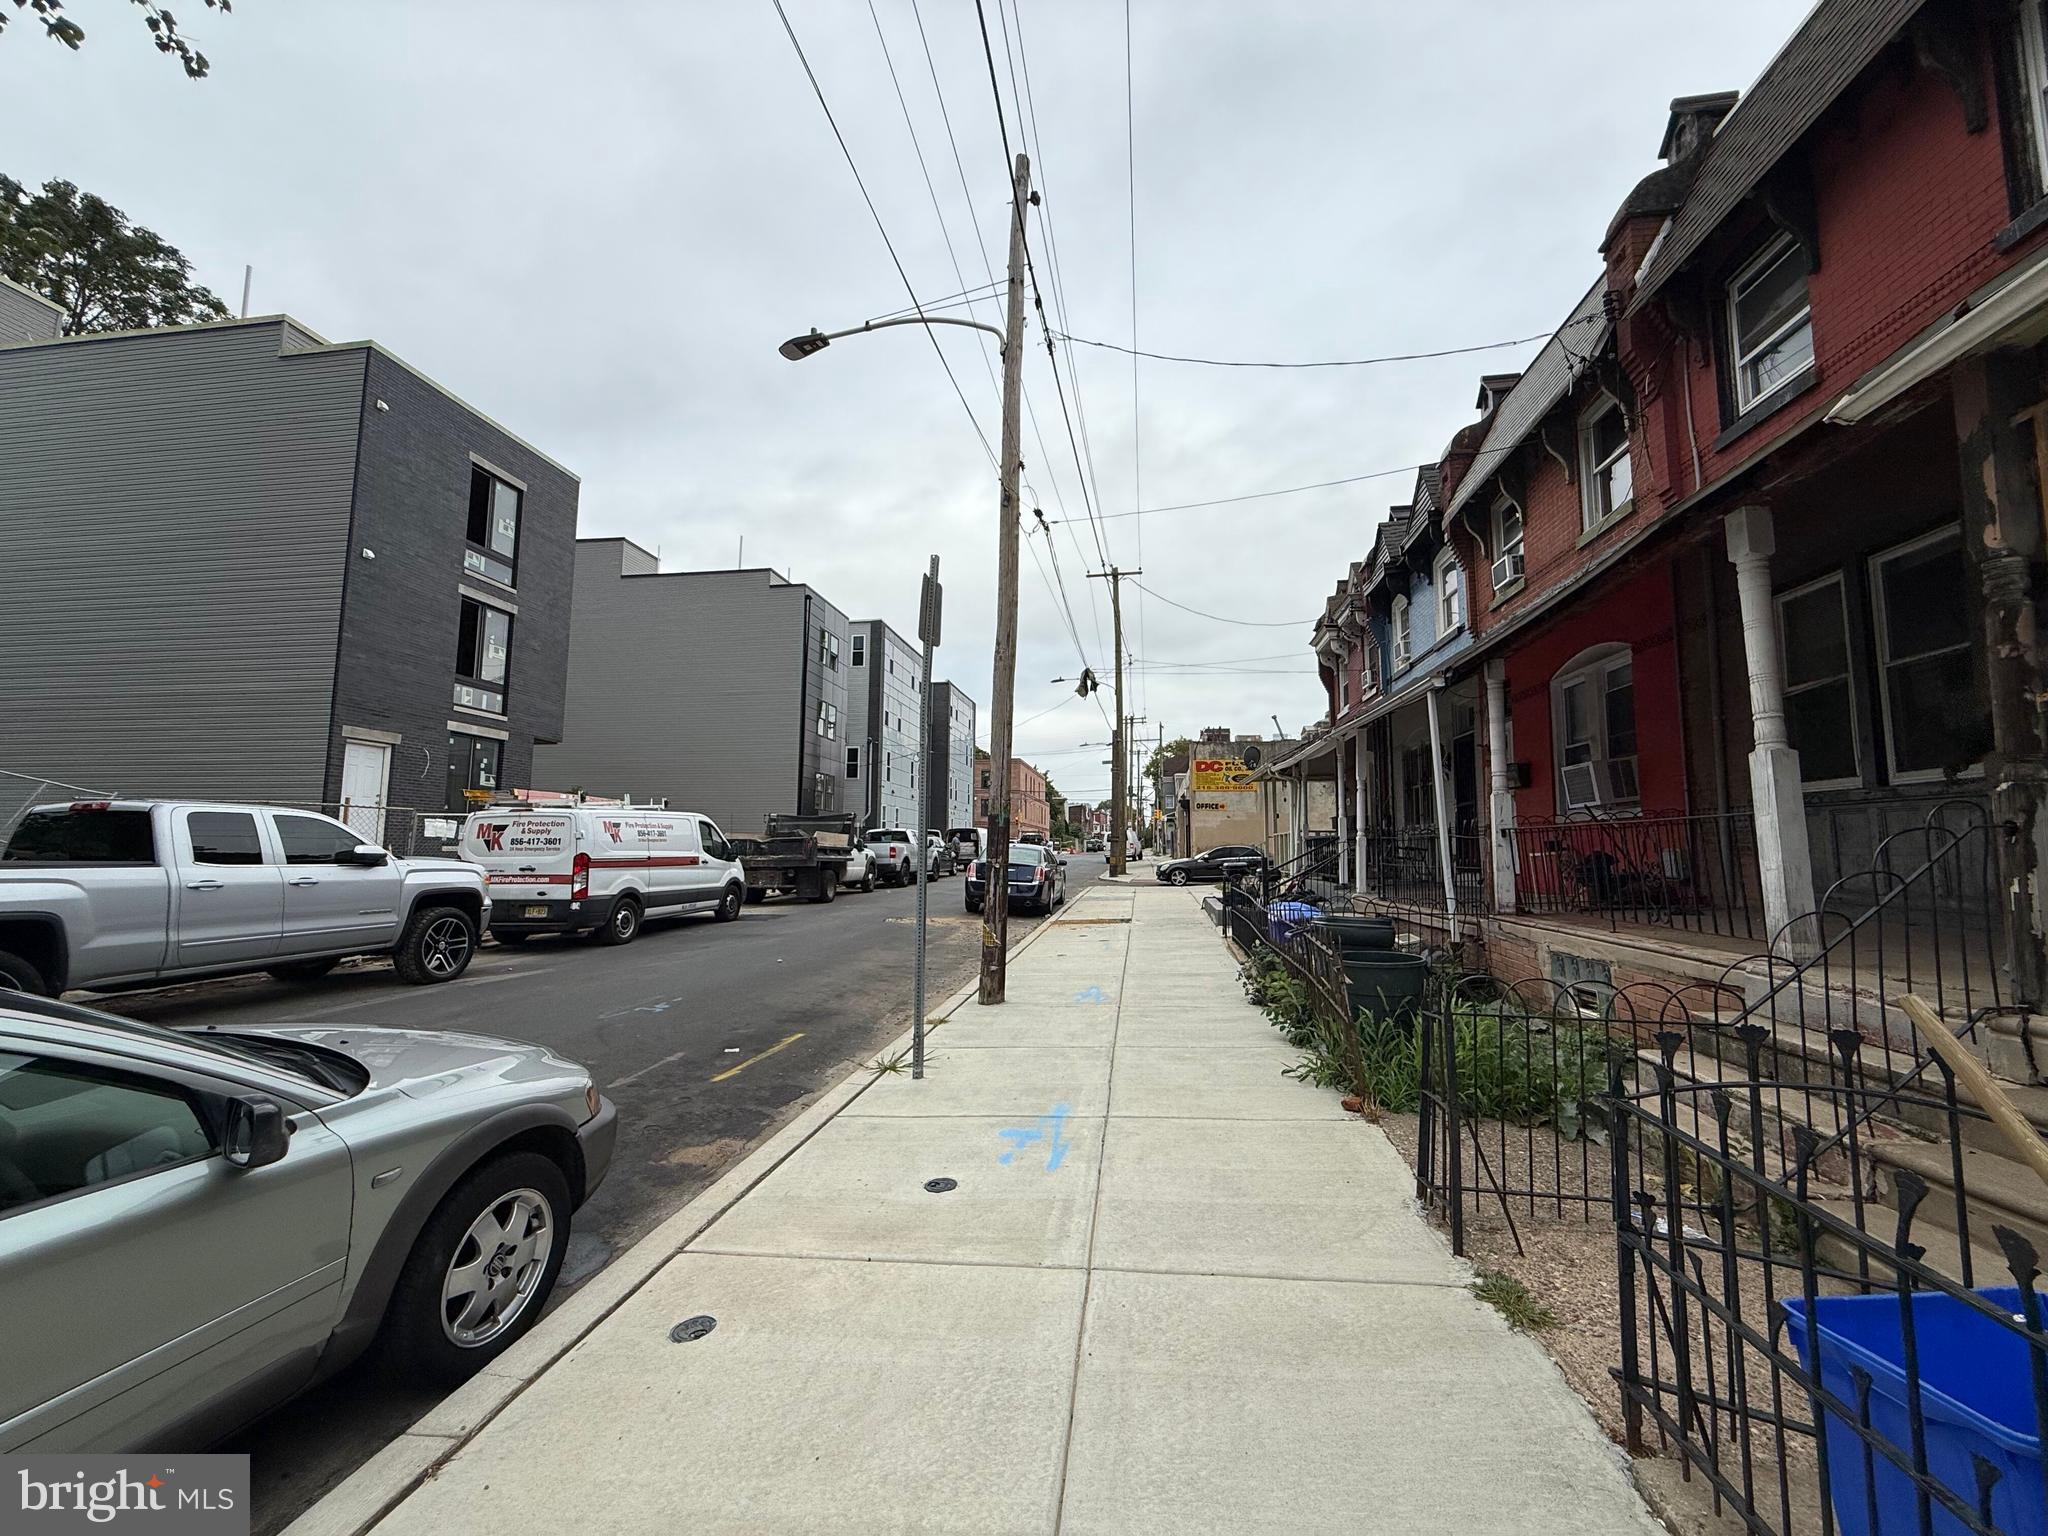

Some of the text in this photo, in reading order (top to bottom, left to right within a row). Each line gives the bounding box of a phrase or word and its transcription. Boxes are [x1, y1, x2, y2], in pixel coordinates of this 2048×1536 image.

[1196, 761, 1223, 773] DC
[511, 820, 565, 828] Fire Protection
[527, 828, 552, 836] Supply
[510, 837, 562, 846] 856-417-3601
